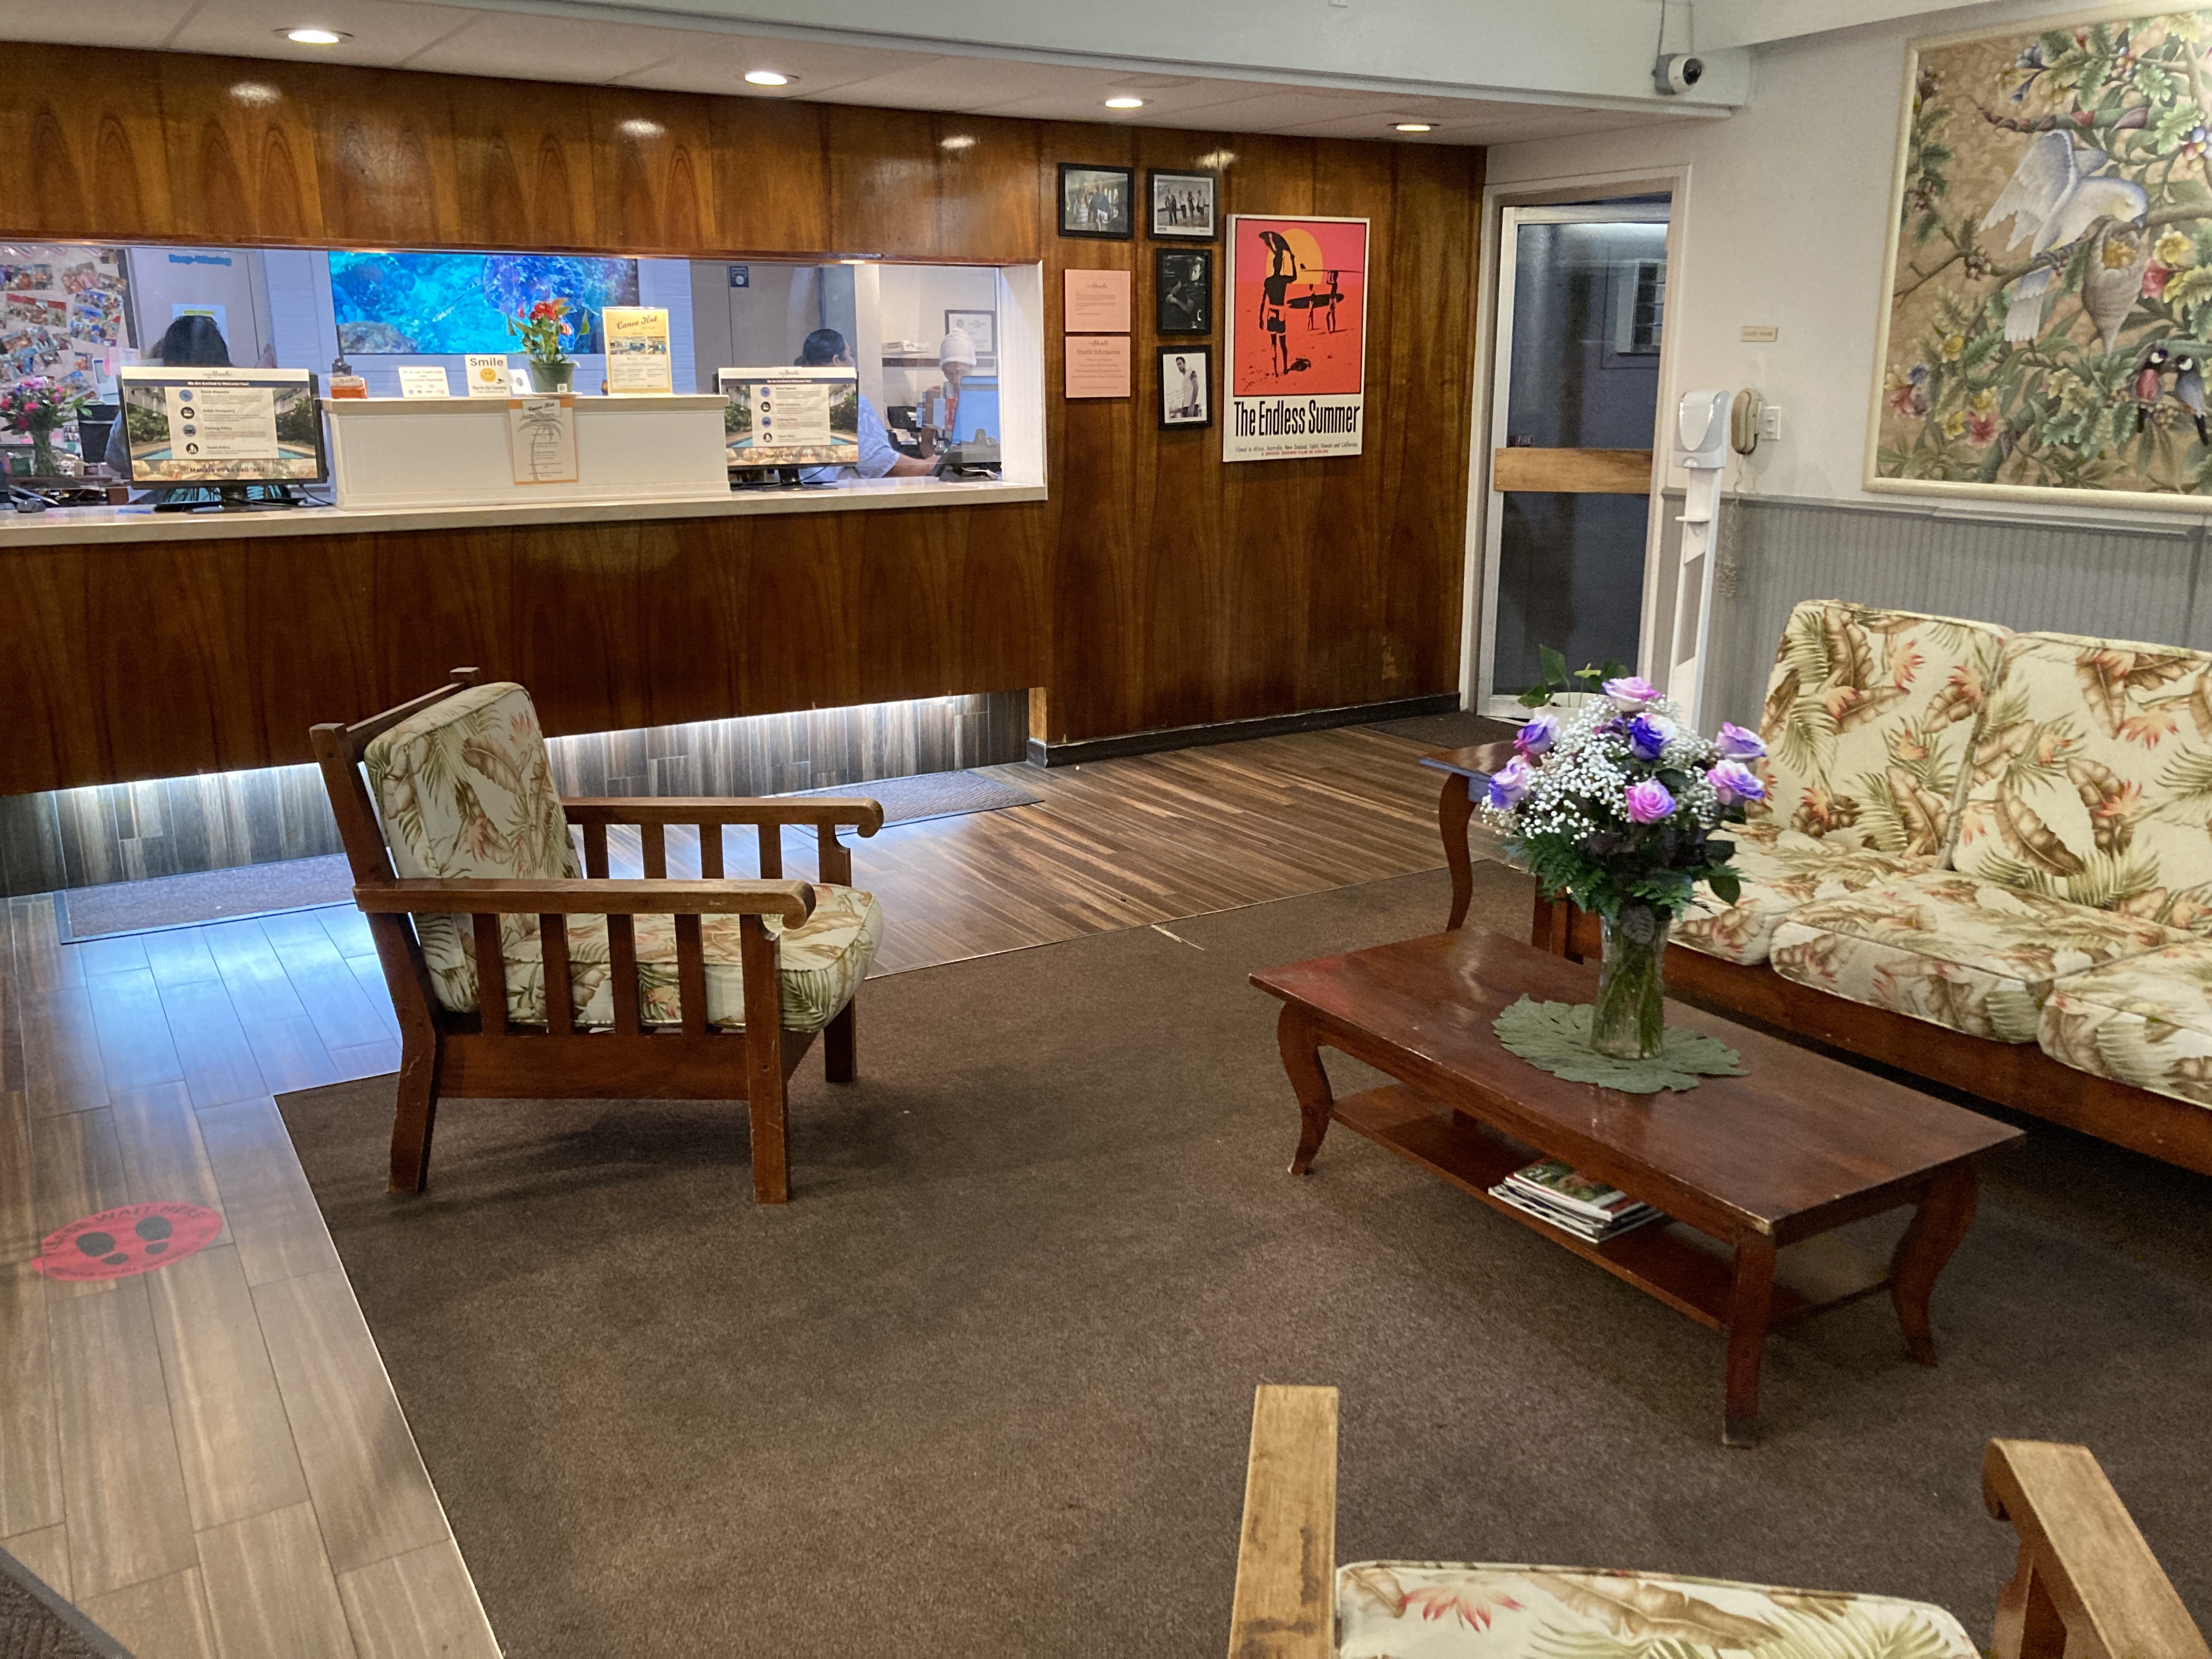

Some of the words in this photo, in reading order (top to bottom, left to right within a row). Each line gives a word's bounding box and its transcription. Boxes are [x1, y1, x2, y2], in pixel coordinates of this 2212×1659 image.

[616, 320, 639, 330] Canoe
[641, 315, 657, 325] Hut
[470, 357, 504, 366] Smile
[1234, 401, 1256, 437] The
[1259, 400, 1306, 436] Endless
[1308, 399, 1361, 434] Summer
[94, 1206, 151, 1222] WAIT
